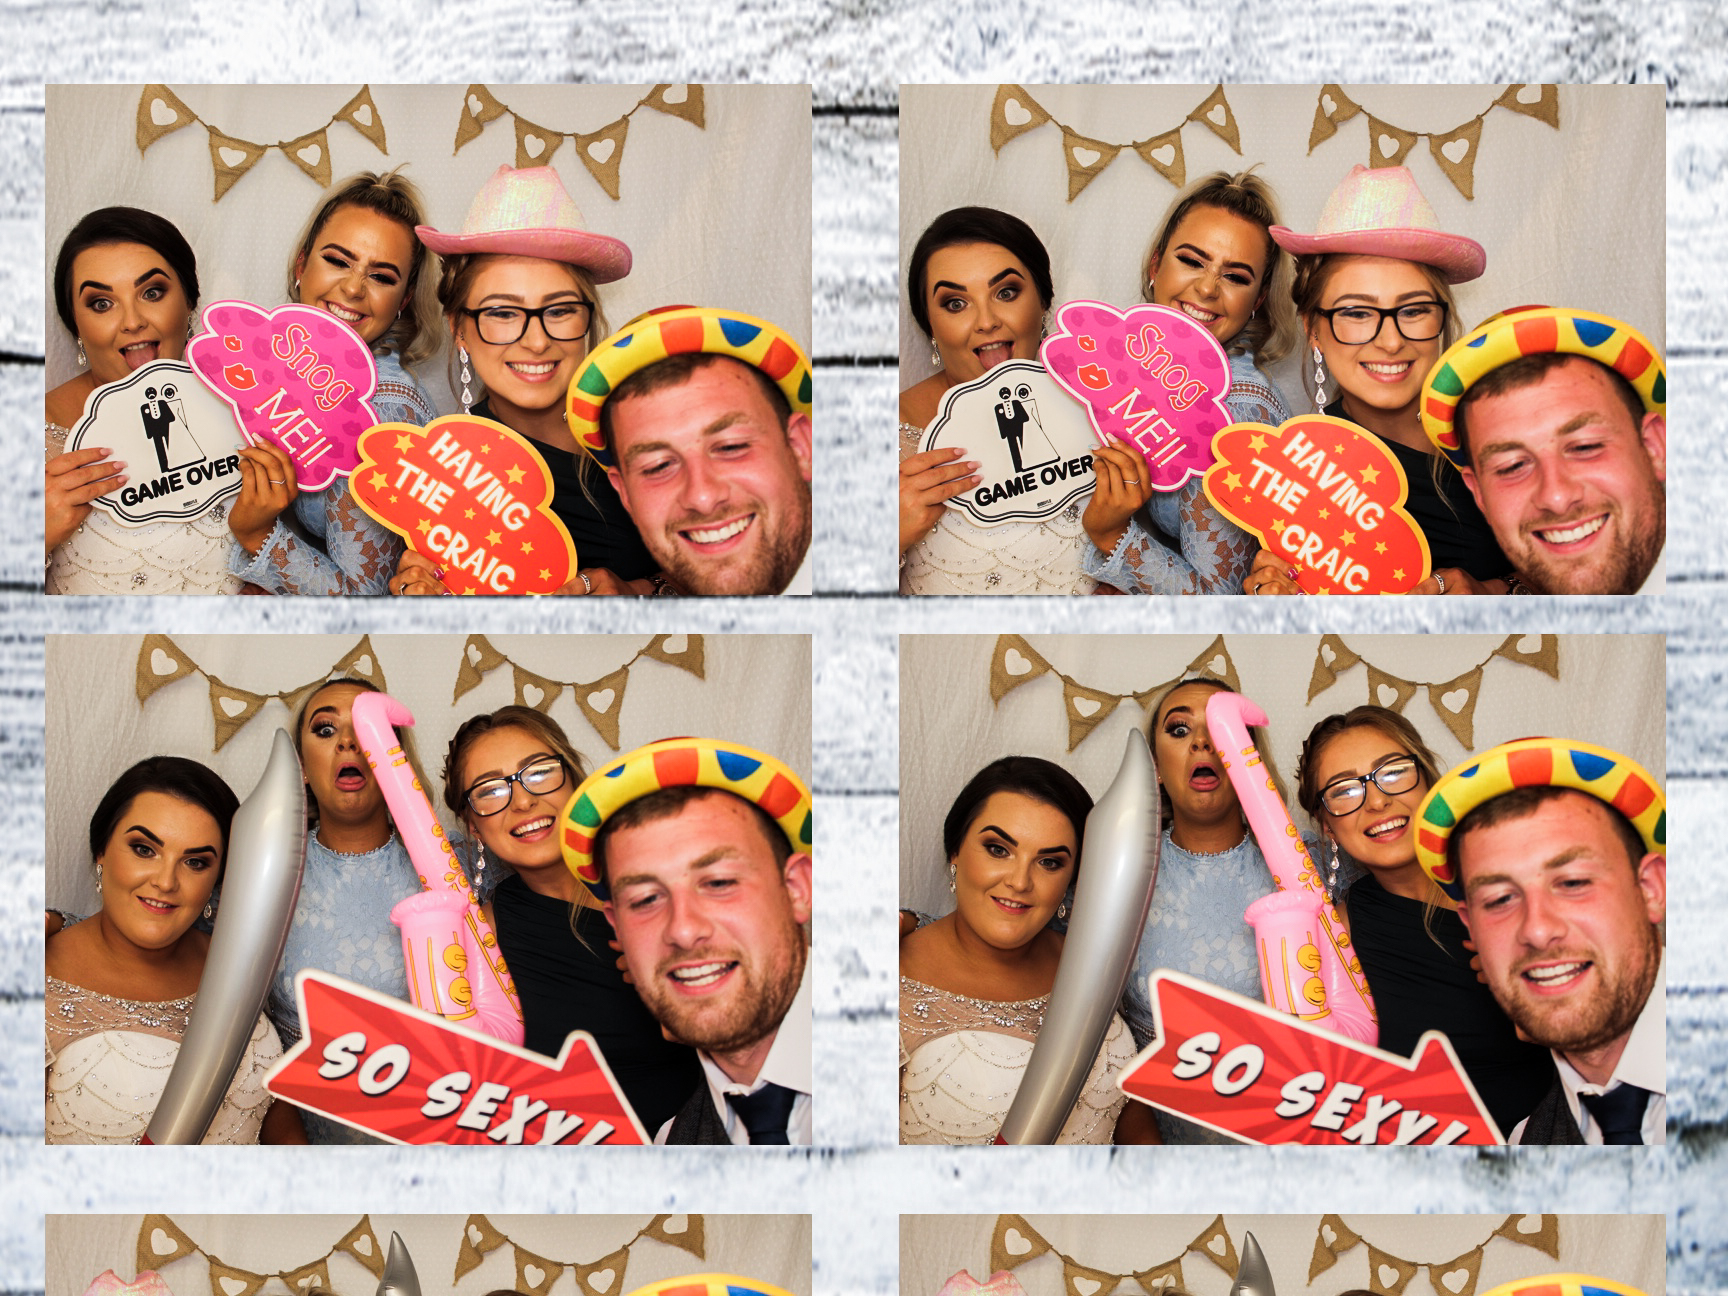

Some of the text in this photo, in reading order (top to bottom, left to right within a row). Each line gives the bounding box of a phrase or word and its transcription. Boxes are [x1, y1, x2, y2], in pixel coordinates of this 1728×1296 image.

[271, 323, 354, 411] Snog
[1125, 323, 1208, 411] Snog
[120, 455, 240, 506] GAME OVER
[394, 457, 456, 515] THE
[428, 430, 531, 531] HAVING
[974, 455, 1094, 506] GAME OVER
[1248, 457, 1310, 515] THE
[1282, 430, 1385, 531] HAVING
[426, 524, 516, 593] CRAIC
[1280, 524, 1370, 593] CRAIC
[318, 1032, 411, 1096] SO
[1172, 1032, 1265, 1096] SO
